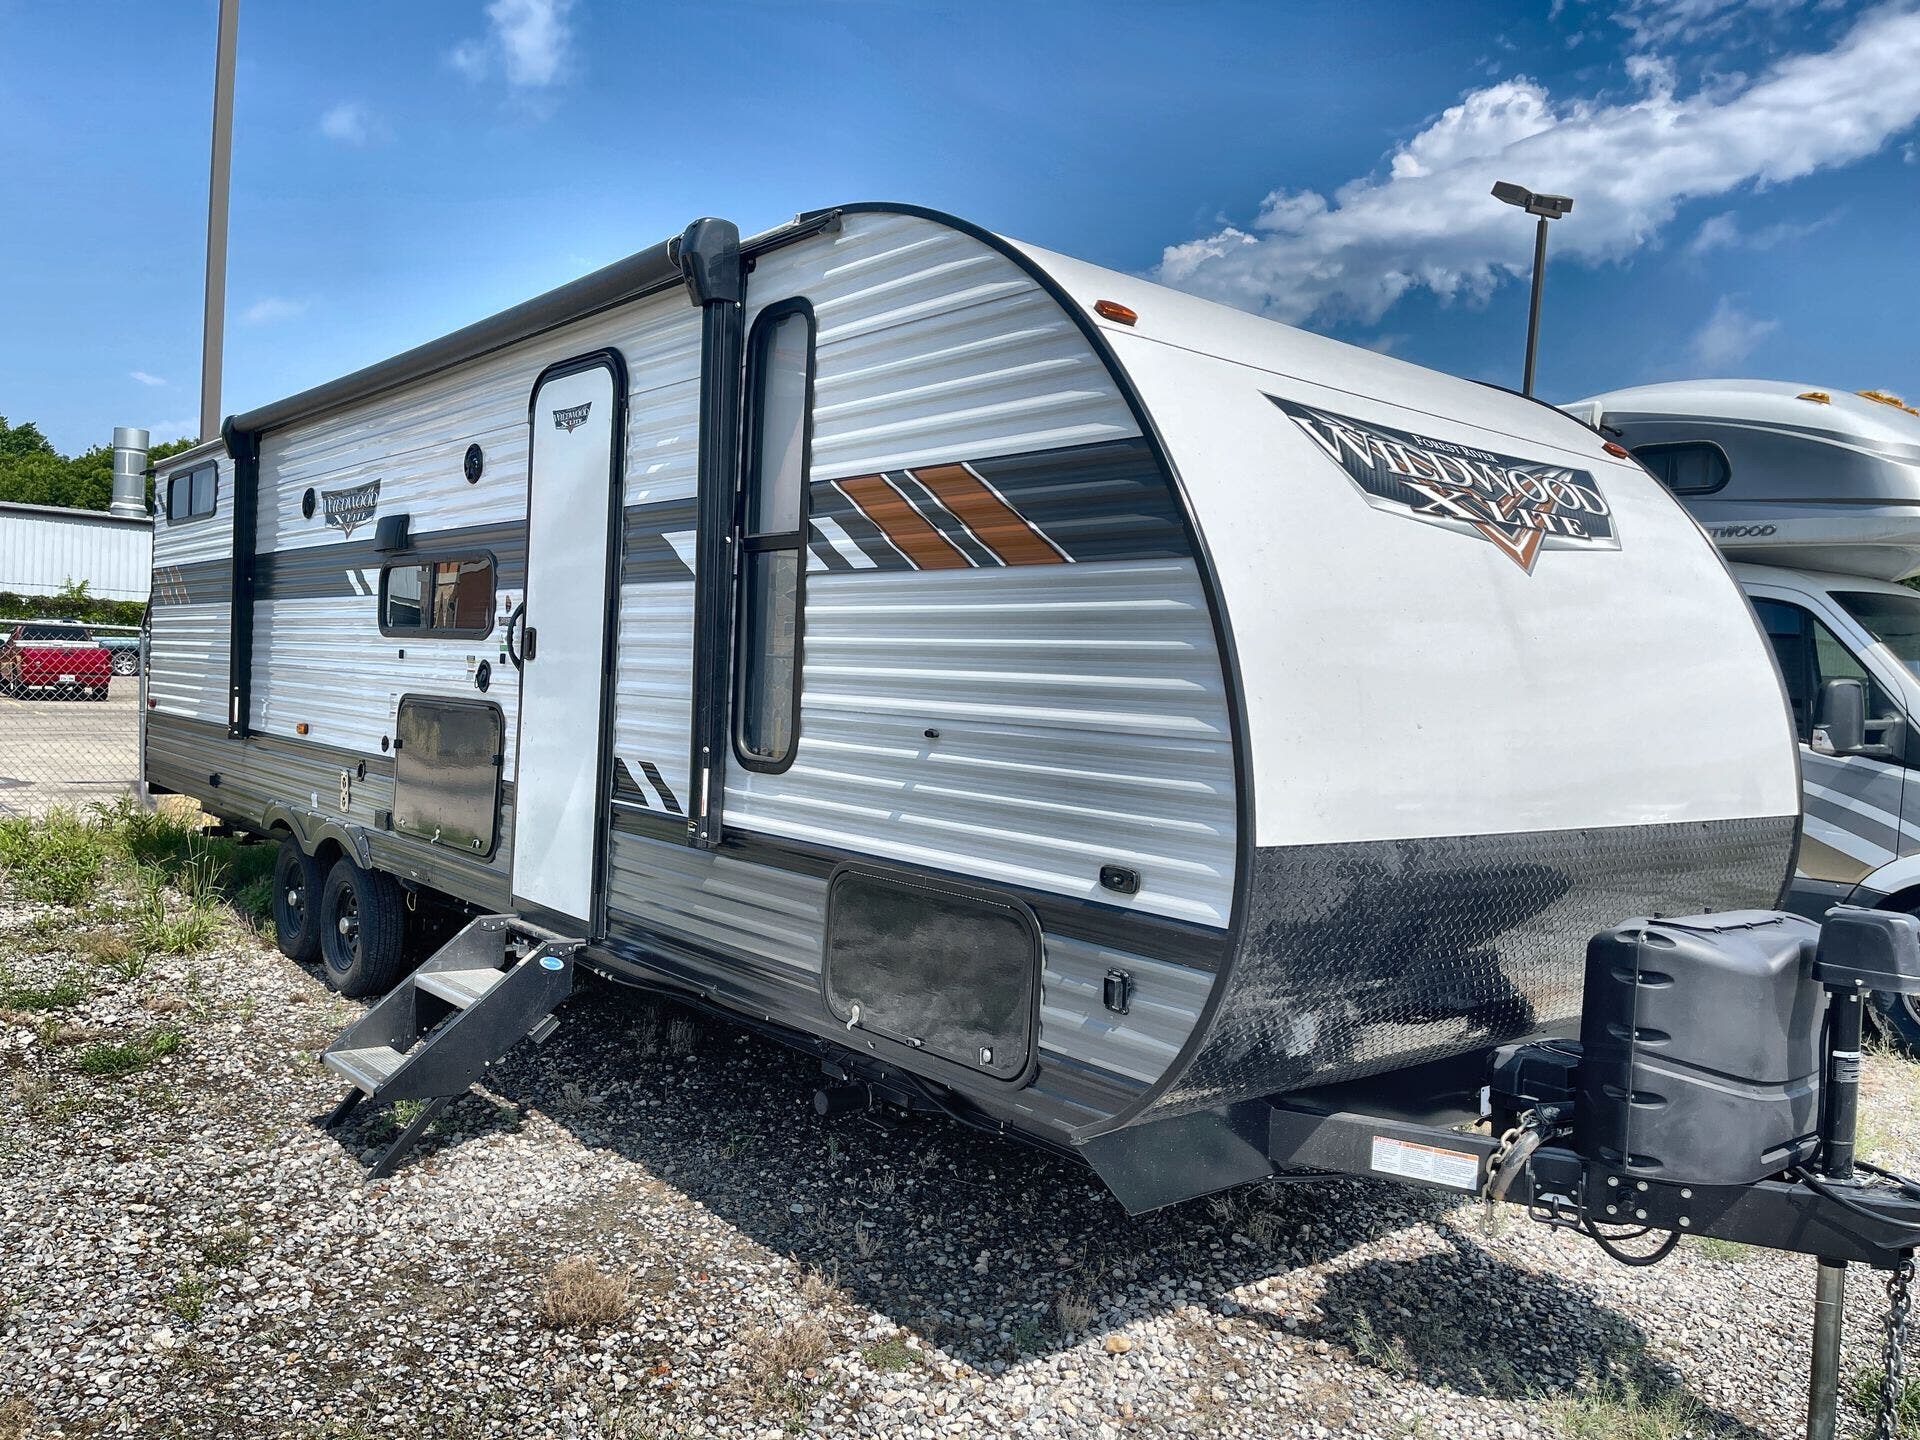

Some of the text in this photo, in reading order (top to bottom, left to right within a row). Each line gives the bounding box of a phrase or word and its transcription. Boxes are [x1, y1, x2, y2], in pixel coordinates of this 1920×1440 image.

[1412, 434, 1499, 464] FOREST RIVER
[1288, 415, 1610, 516] WILDWOOD
[1706, 525, 1777, 538] TWOOD
